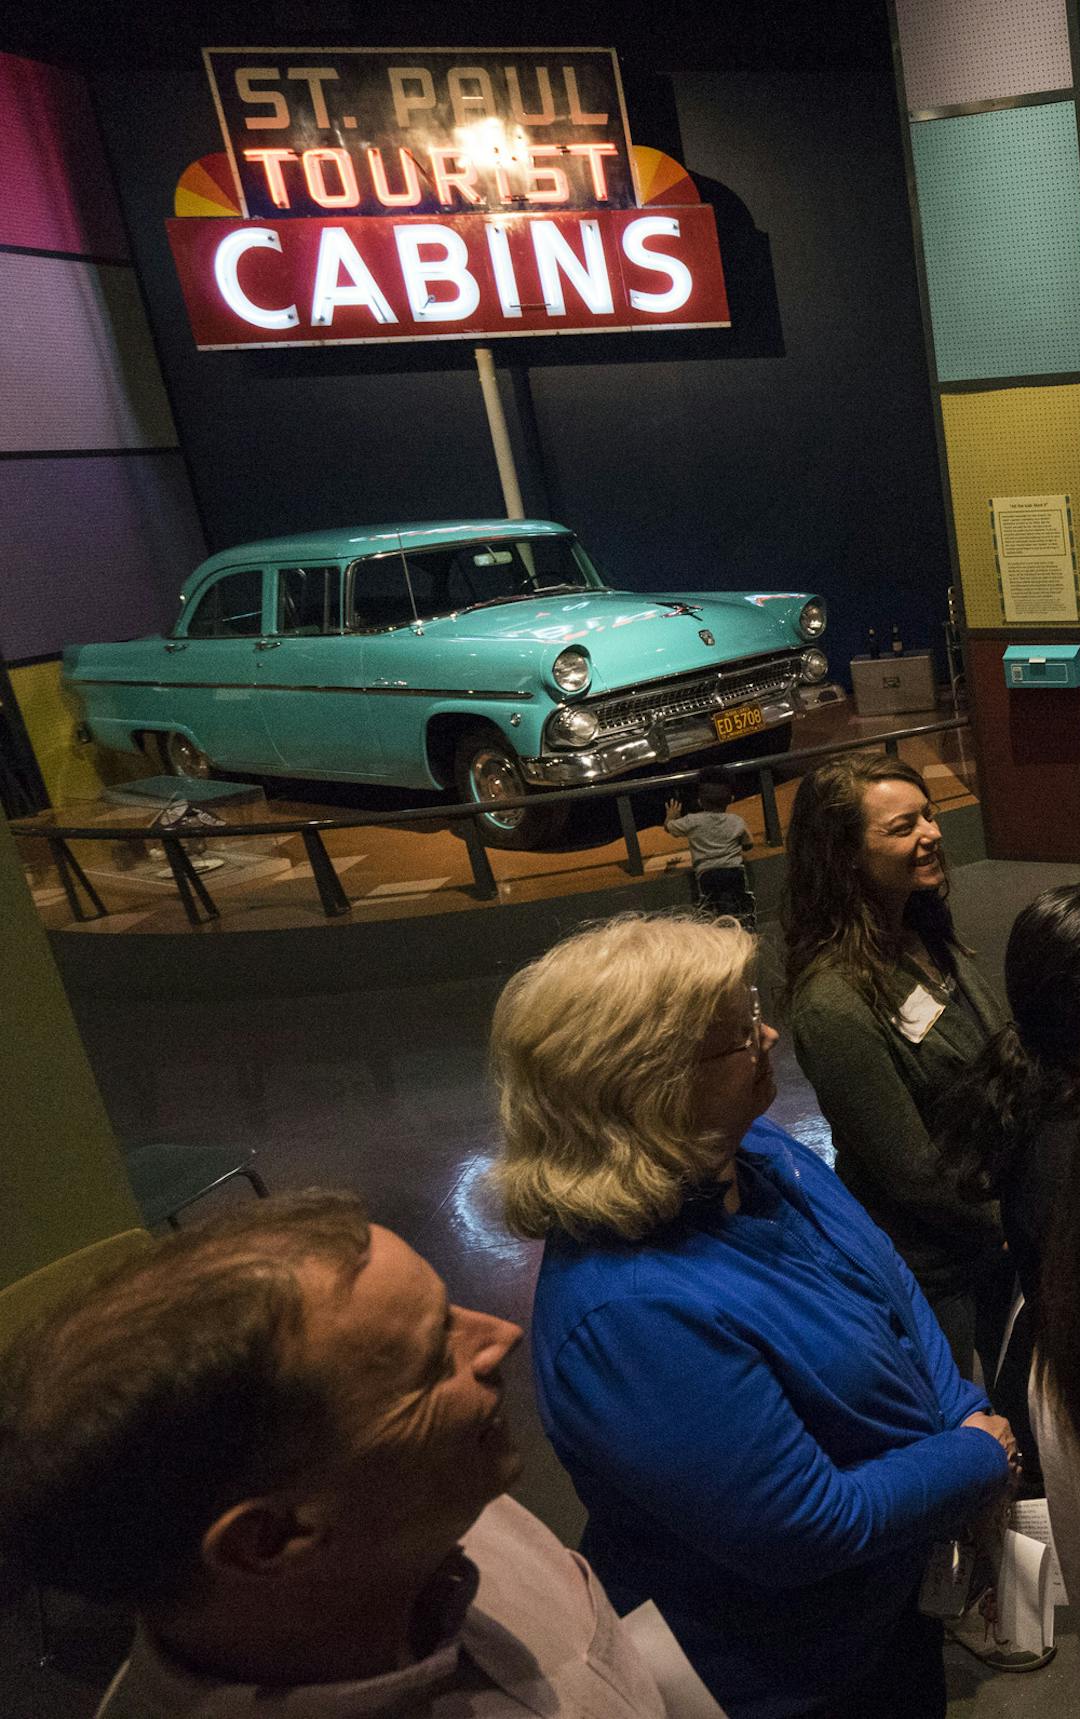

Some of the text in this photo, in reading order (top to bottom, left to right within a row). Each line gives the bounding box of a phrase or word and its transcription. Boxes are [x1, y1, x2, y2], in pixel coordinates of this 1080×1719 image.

[234, 65, 610, 130] ST. PAUL
[243, 141, 618, 210] TOURIST
[213, 216, 693, 330] CABINS
[733, 709, 761, 730] 5708
